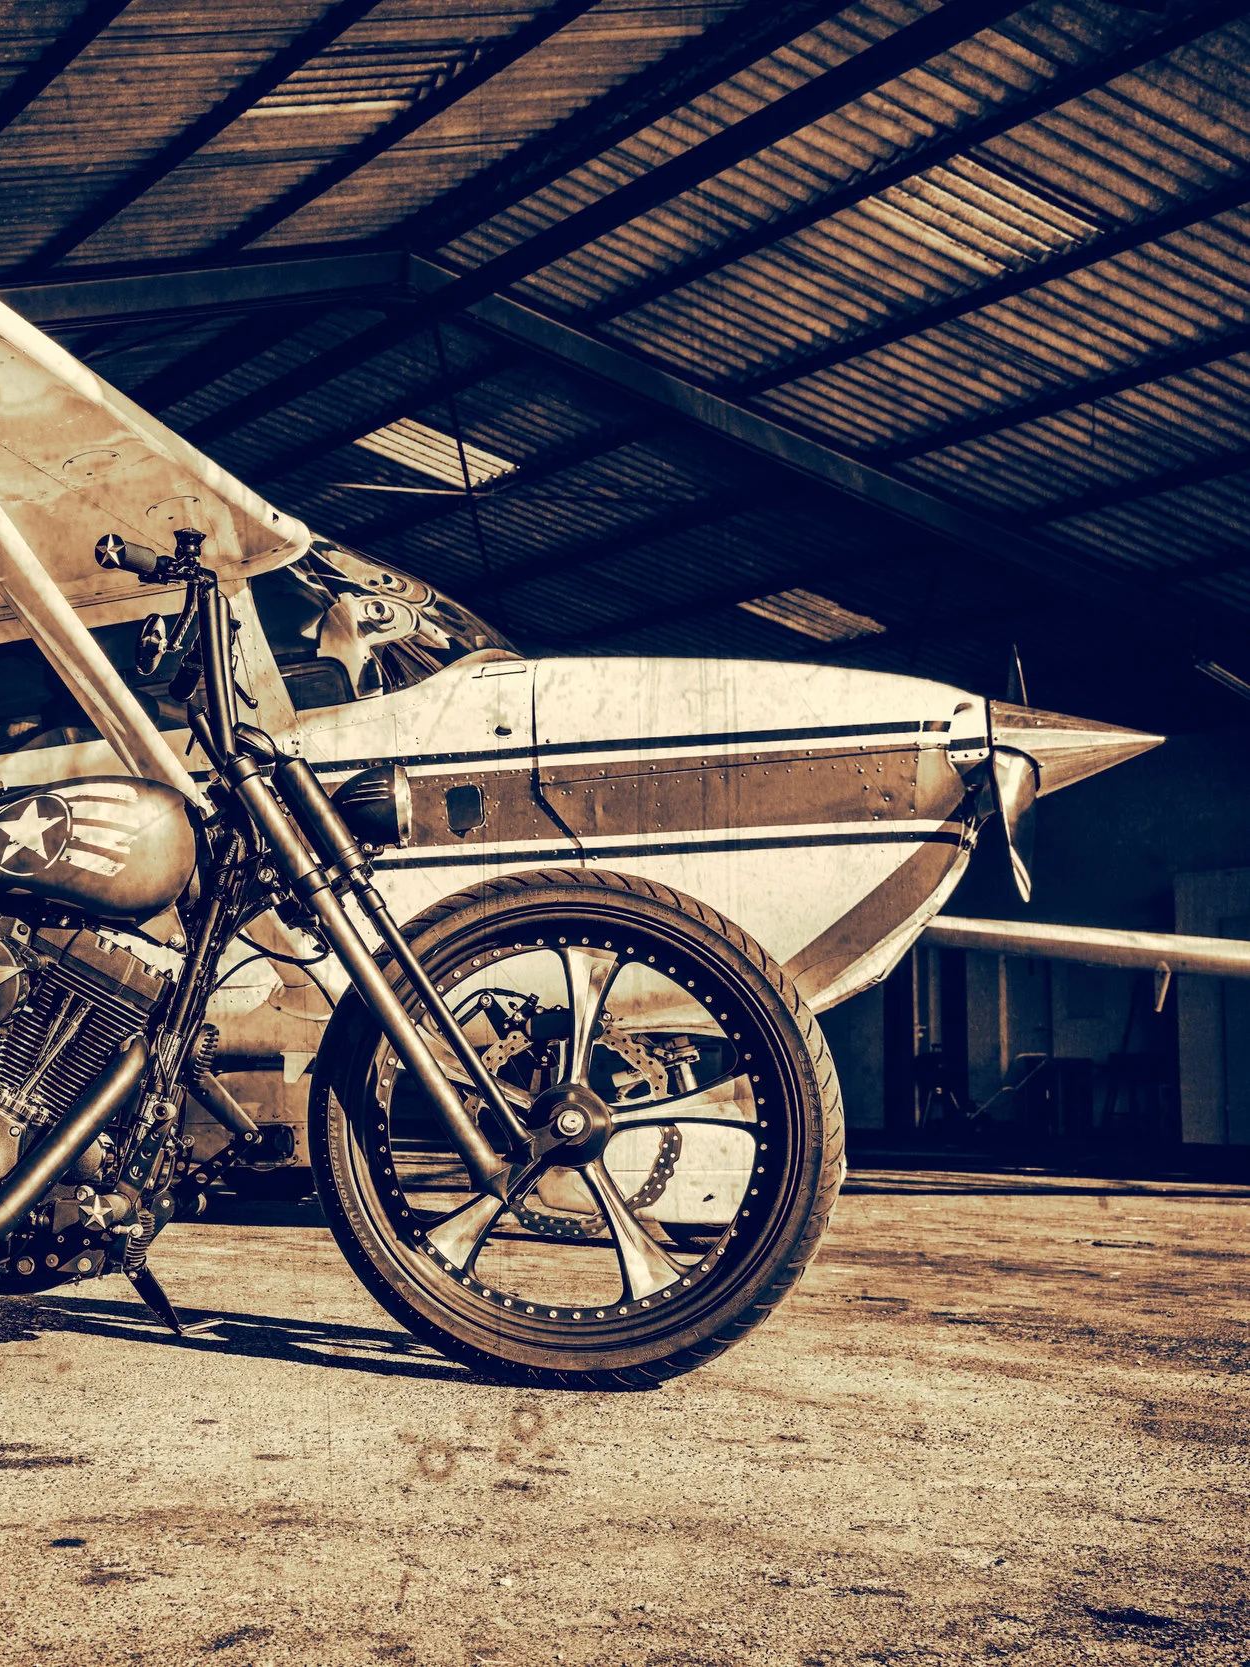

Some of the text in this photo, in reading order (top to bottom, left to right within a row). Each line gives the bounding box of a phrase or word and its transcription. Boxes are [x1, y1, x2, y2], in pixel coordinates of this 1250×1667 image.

[797, 1049, 823, 1149] METZELER
[329, 1120, 352, 1209] MARATHON
[349, 1211, 379, 1259] ULTRA
